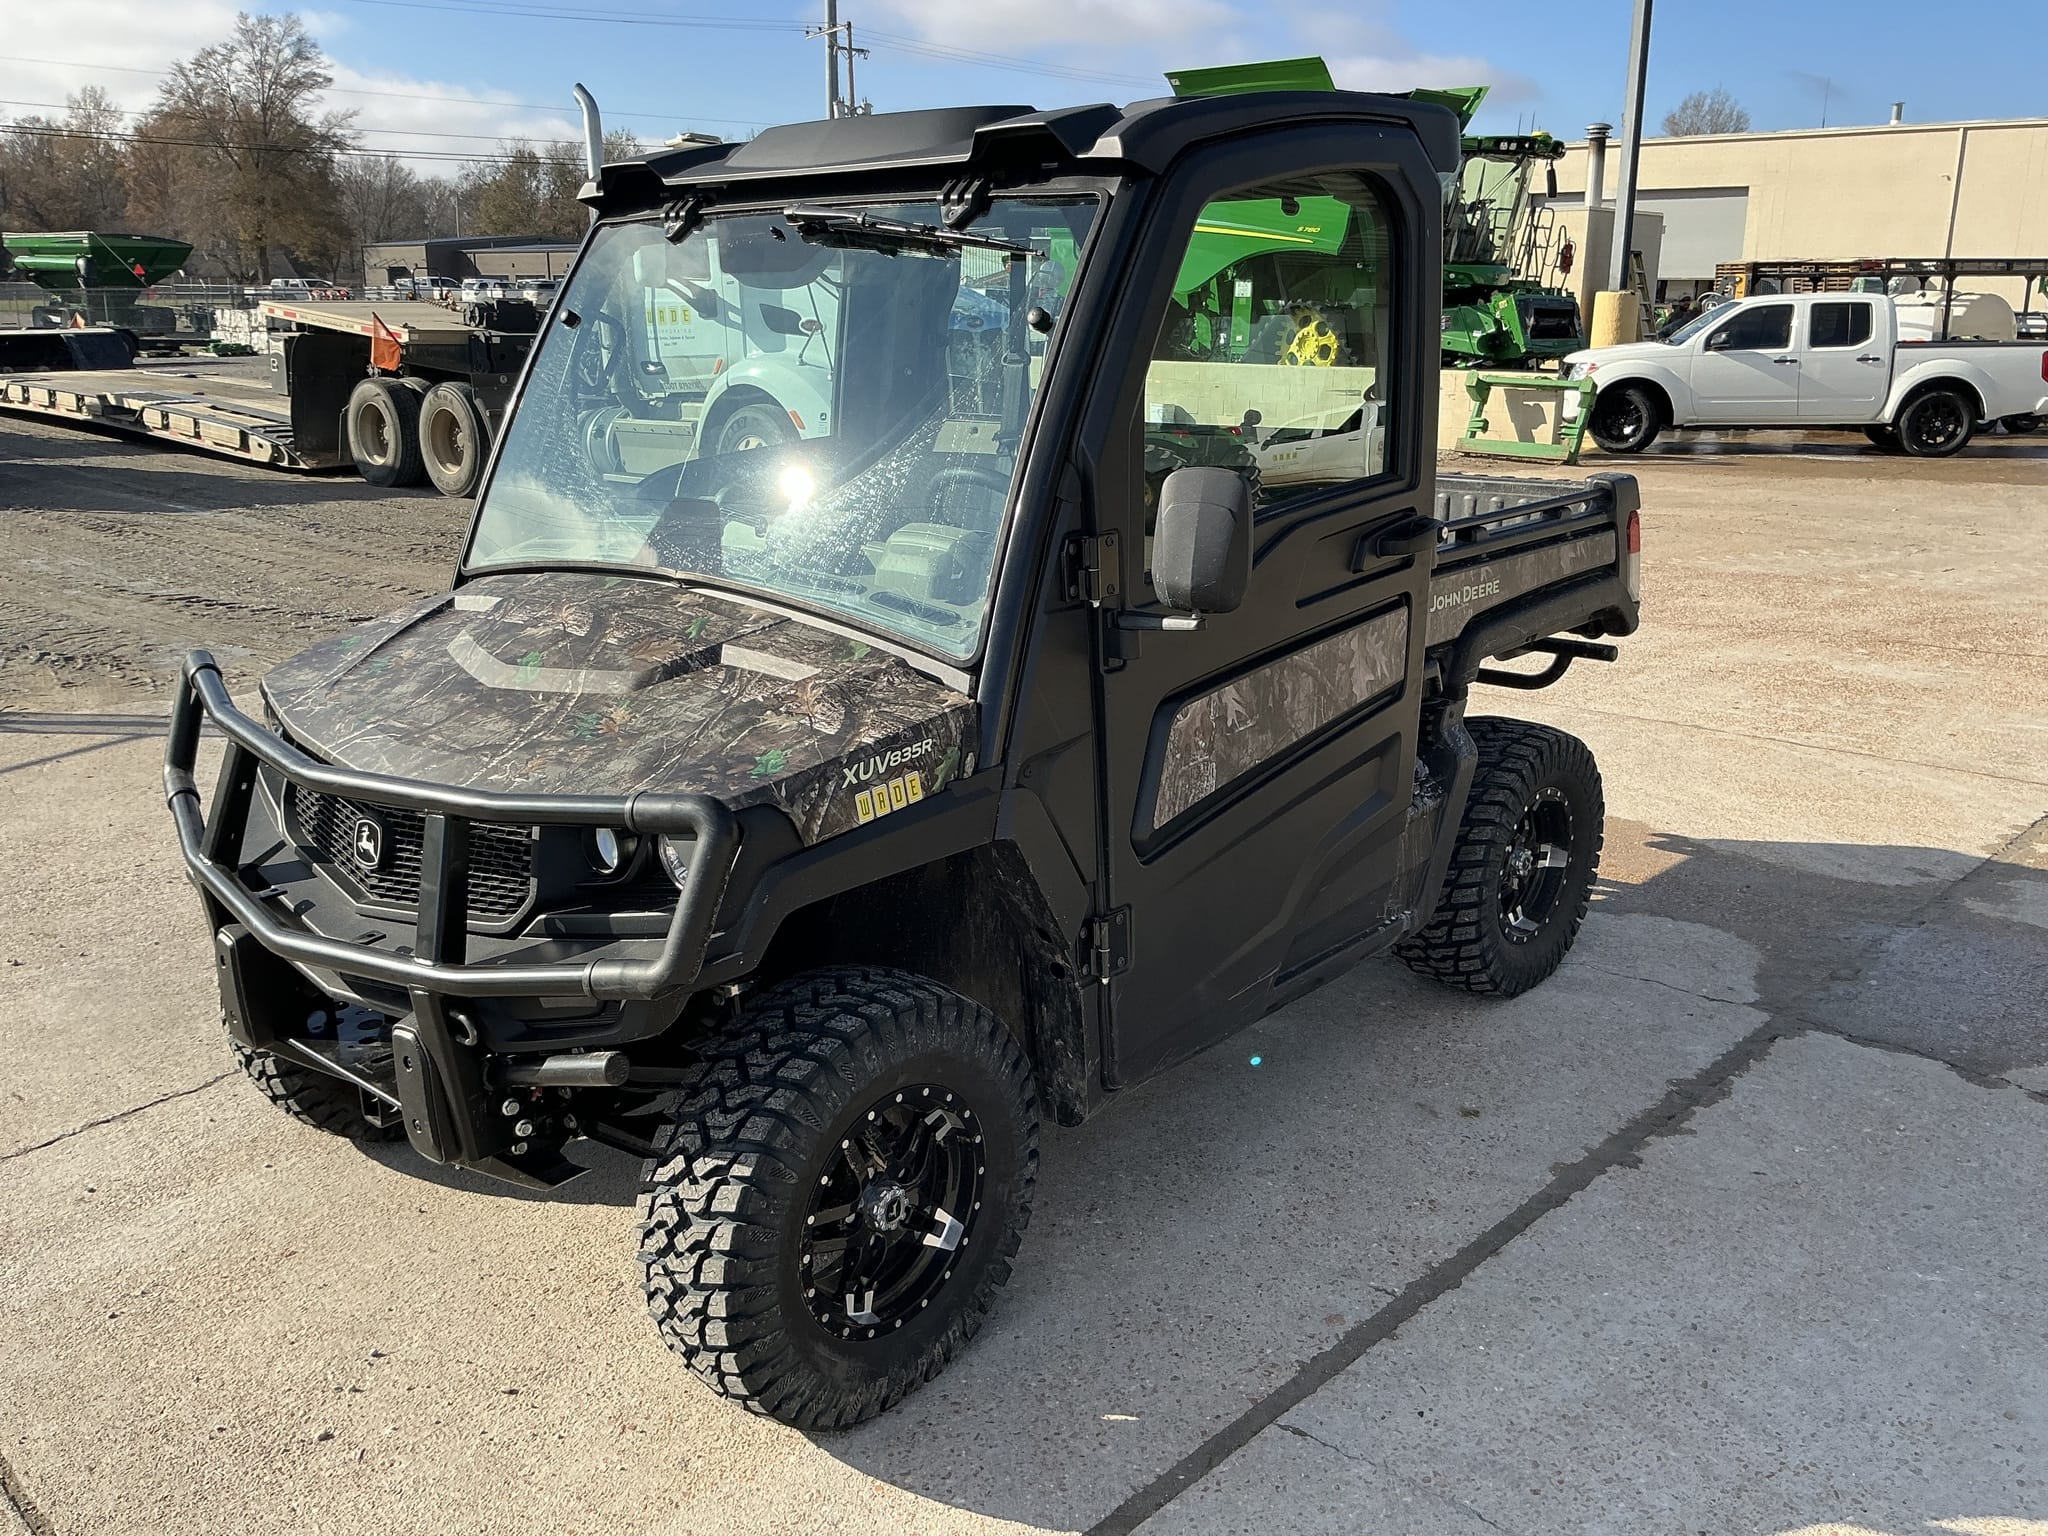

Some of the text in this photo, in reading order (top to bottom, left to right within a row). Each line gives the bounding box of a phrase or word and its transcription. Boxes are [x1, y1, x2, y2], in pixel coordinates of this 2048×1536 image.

[1429, 579, 1500, 613] JOHN DEERE
[841, 738, 933, 789] XUV835R
[857, 776, 921, 819] WADE
